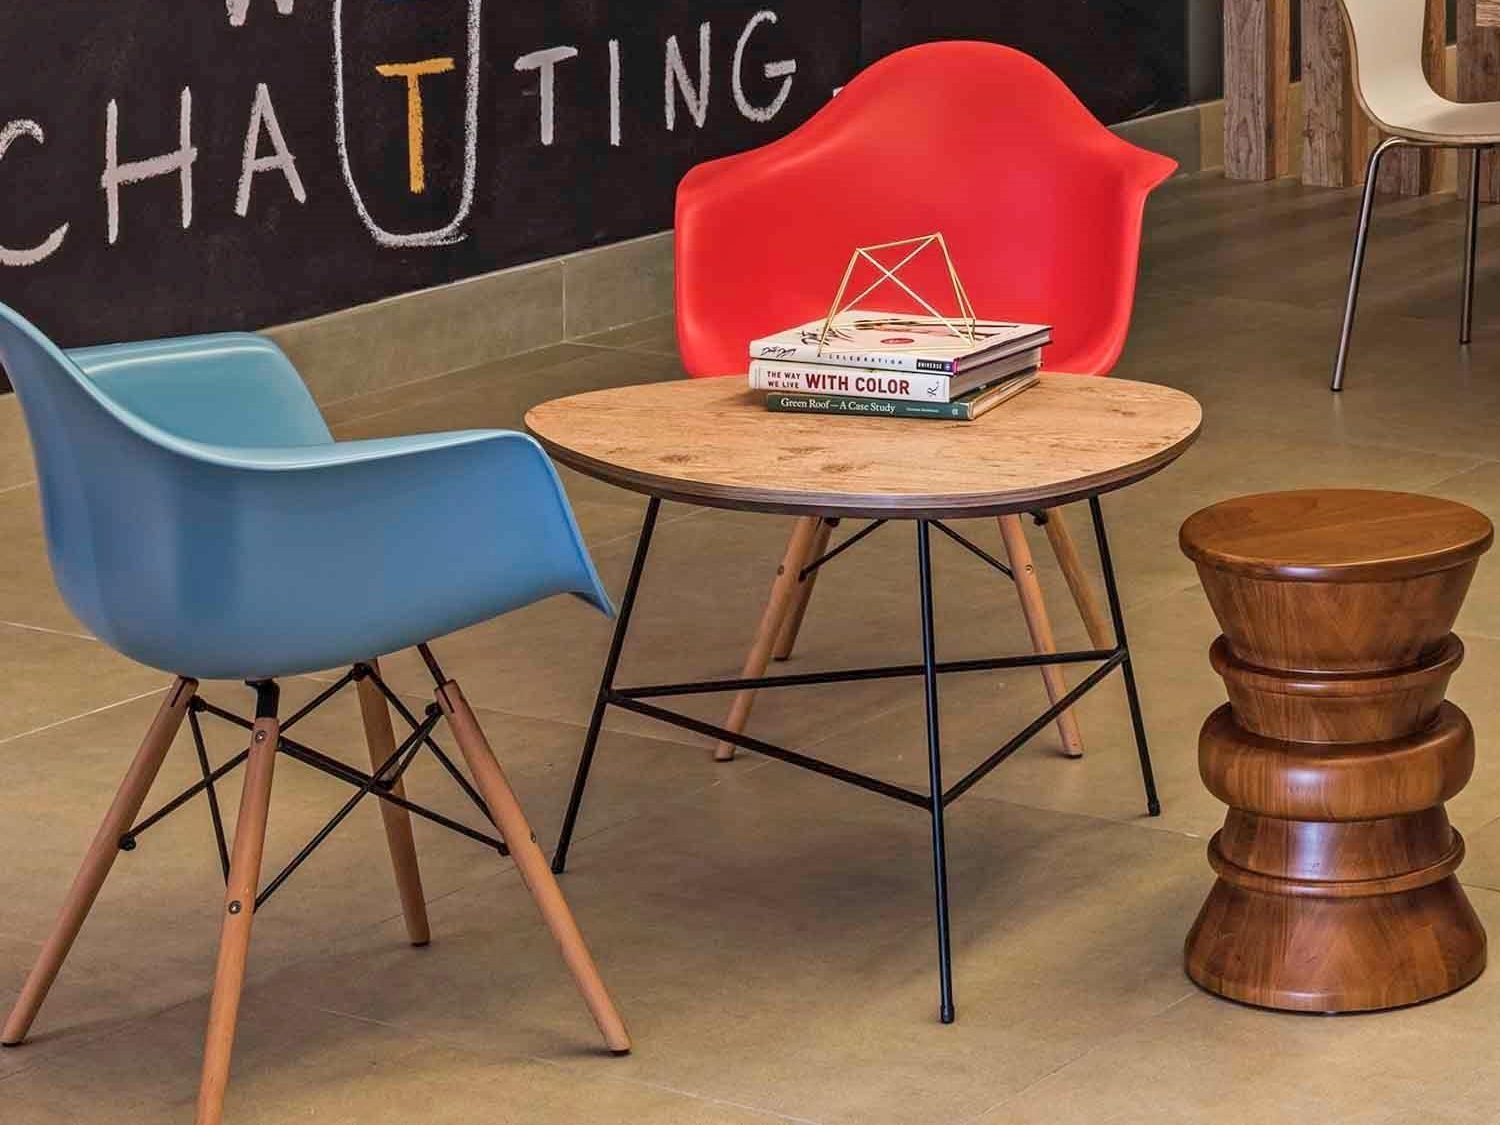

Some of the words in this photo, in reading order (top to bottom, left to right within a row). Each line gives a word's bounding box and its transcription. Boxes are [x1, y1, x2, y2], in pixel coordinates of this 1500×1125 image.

[767, 371, 781, 379] THE
[785, 372, 801, 380] WAY
[805, 373, 849, 391] WITH
[855, 377, 911, 395] COLOR
[780, 397, 807, 408] Green
[848, 401, 869, 411] Case
[870, 402, 896, 414] Study
